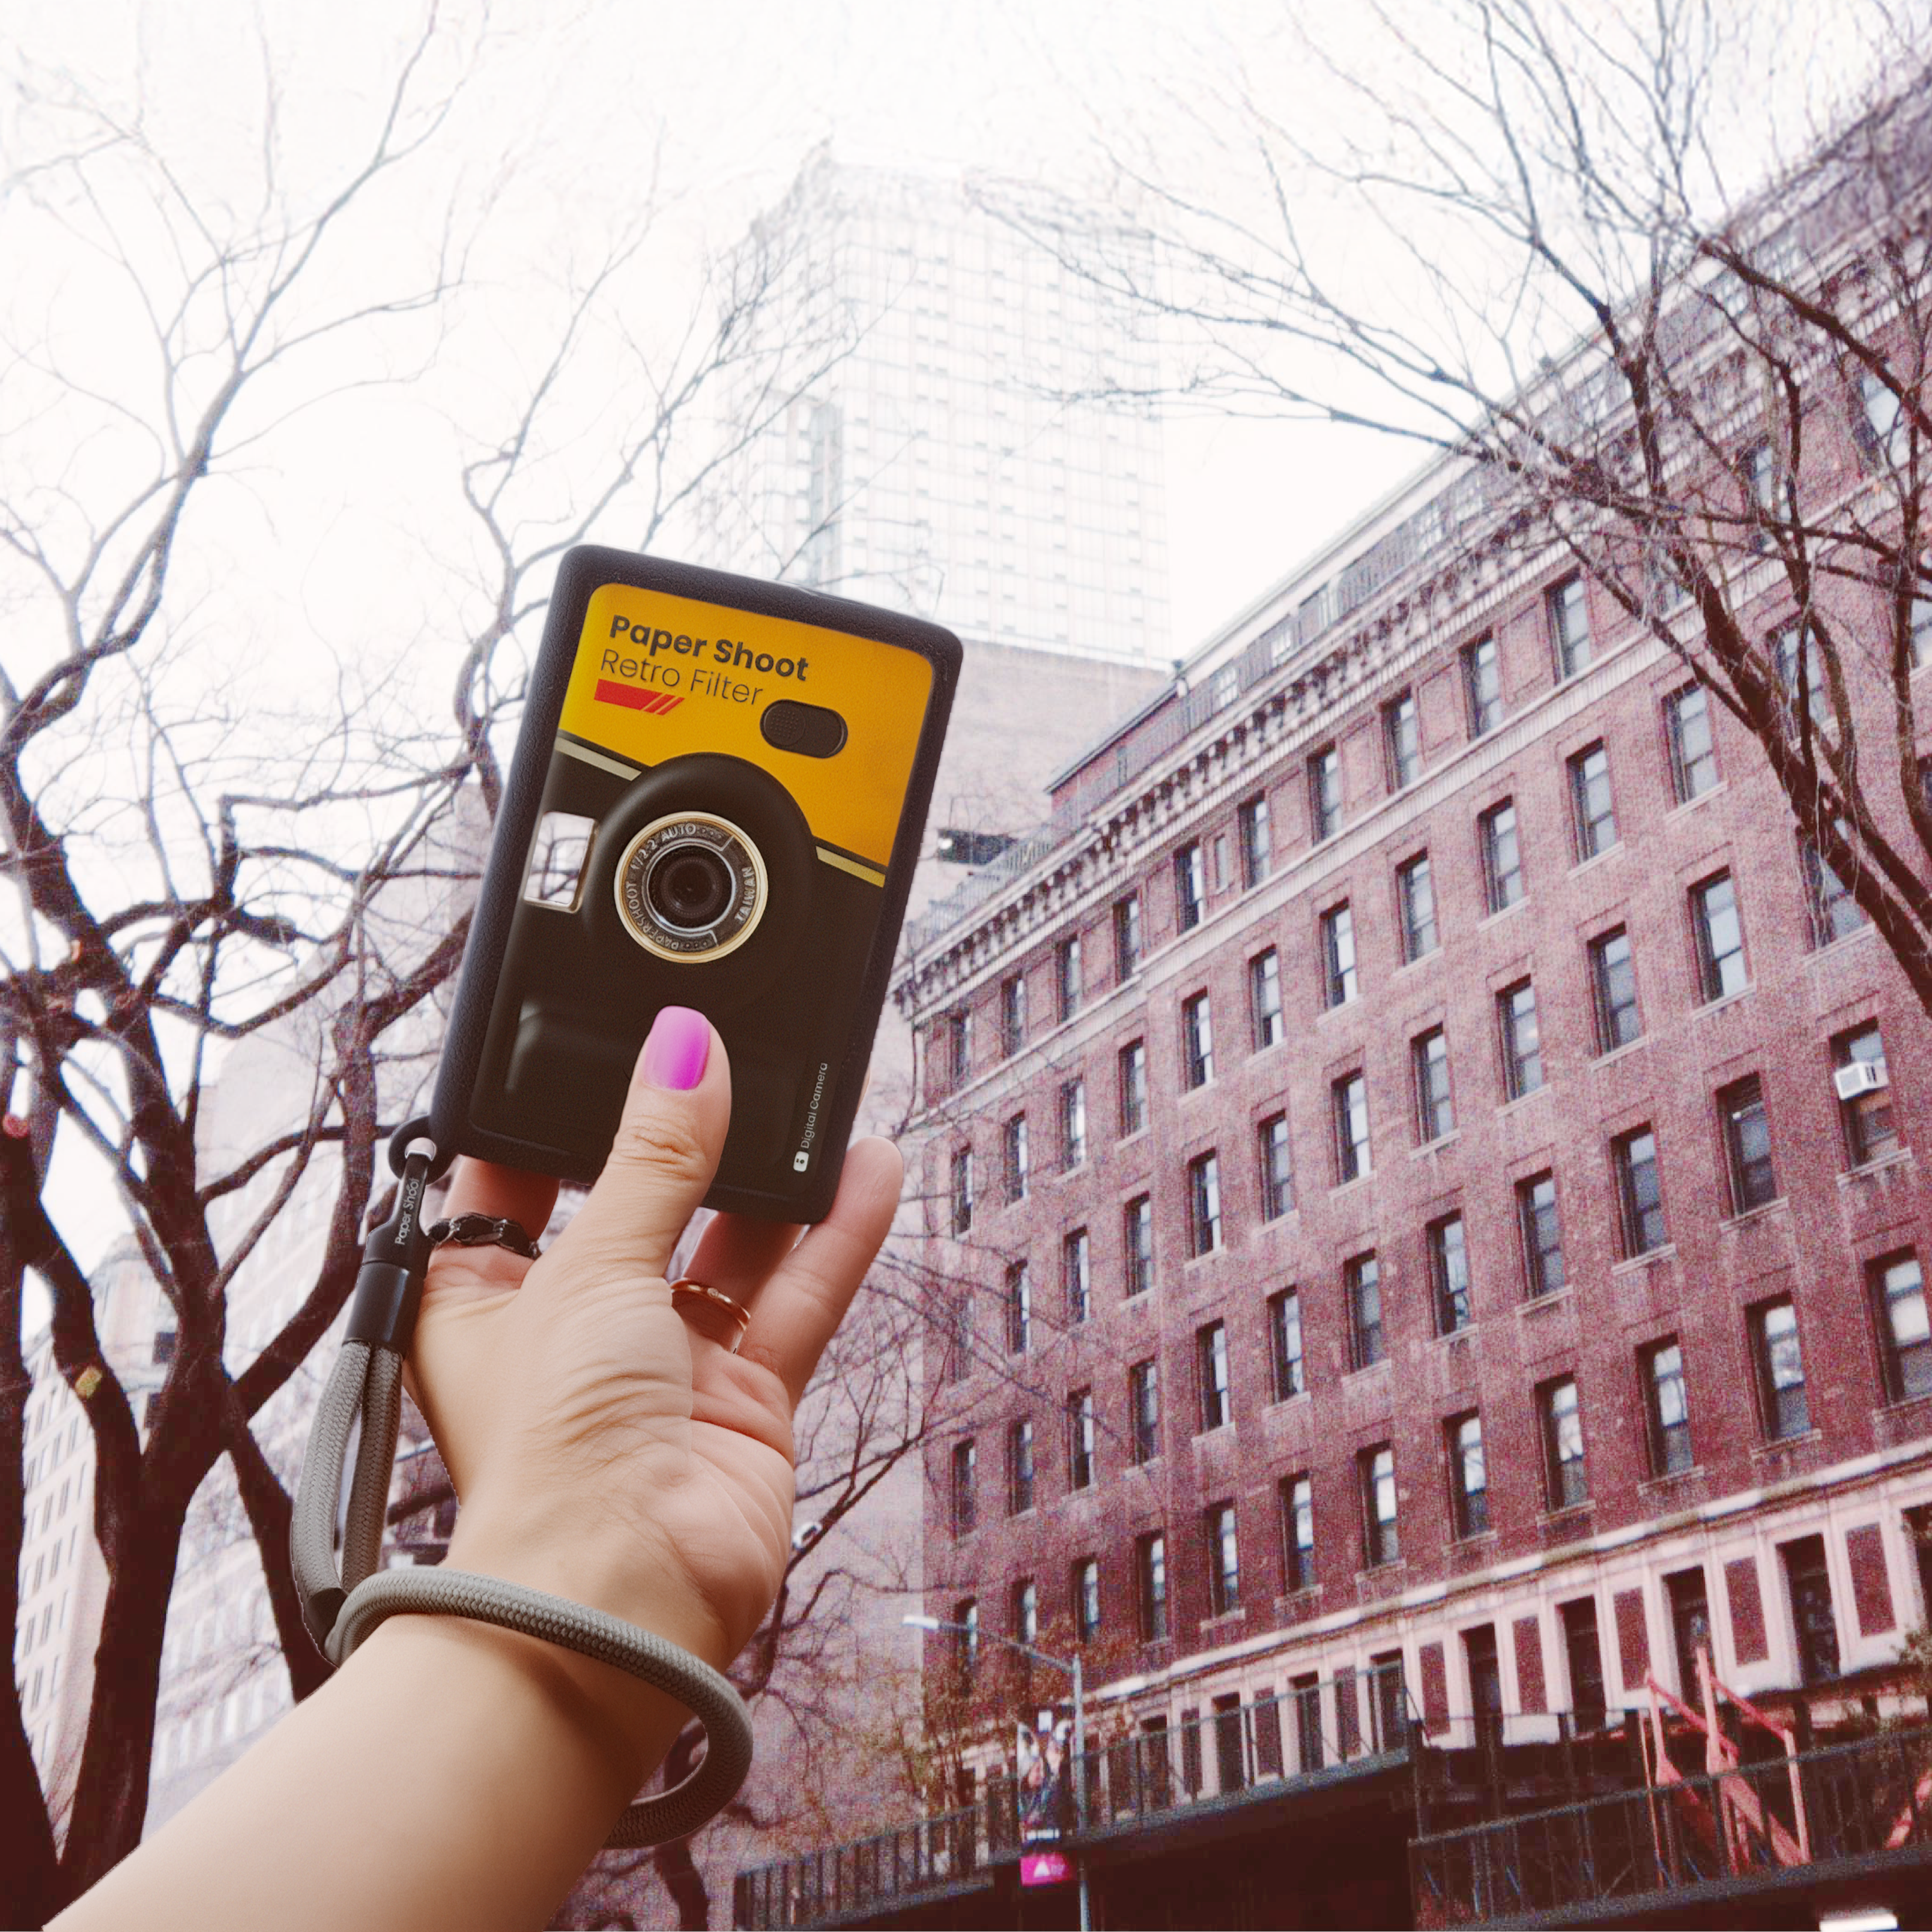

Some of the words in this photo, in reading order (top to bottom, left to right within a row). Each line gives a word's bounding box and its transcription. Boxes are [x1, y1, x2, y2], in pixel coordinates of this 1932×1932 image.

[600, 649, 680, 687] Retro
[690, 668, 763, 706] Filter
[608, 614, 707, 657] Paper
[713, 638, 809, 681] Shoot
[661, 823, 696, 842] AUTO
[734, 867, 756, 923] TAIWAN
[801, 1112, 817, 1149] Digital
[810, 1062, 828, 1110] Camera
[395, 1211, 411, 1245] Paper
[403, 1178, 419, 1210] Shoot
